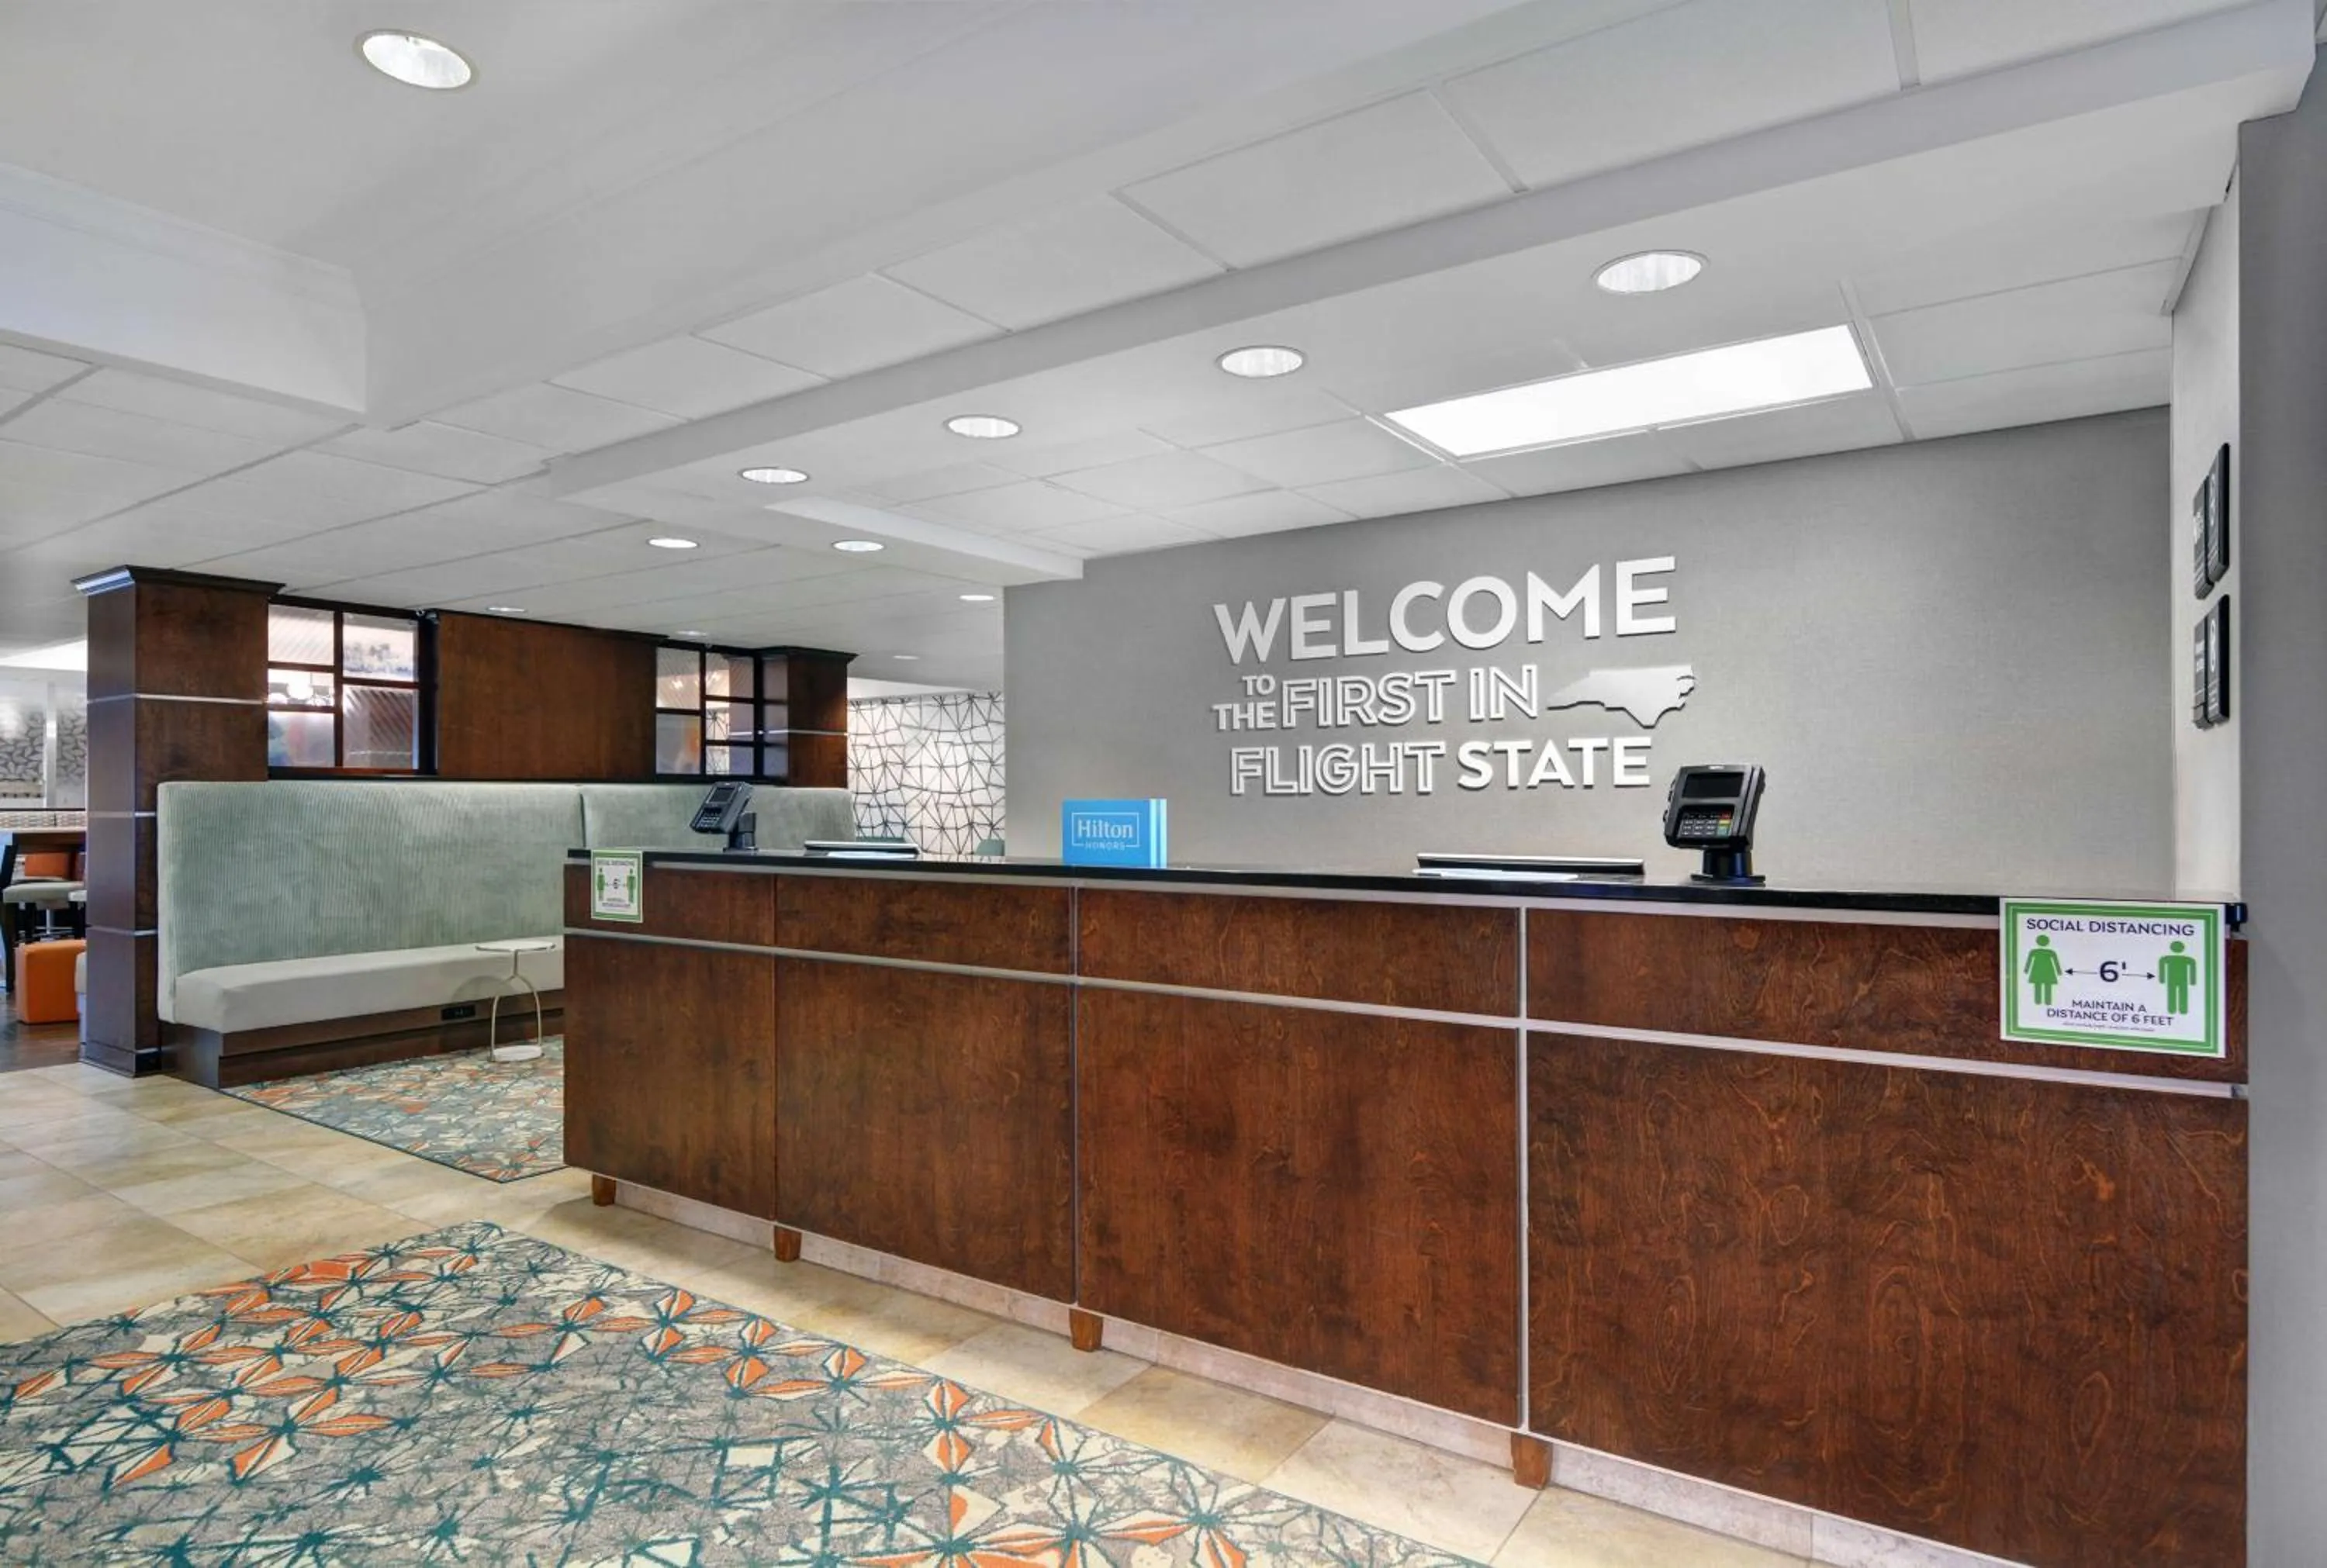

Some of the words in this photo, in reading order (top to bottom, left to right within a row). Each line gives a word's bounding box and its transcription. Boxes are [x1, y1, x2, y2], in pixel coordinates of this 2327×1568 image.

[1213, 556, 1676, 665] WELCOME
[1243, 675, 1275, 696] TO
[1282, 670, 1456, 728] FIRST
[1470, 665, 1537, 721] IN
[1213, 701, 1276, 730] THE
[1231, 742, 1446, 795] FLIGHT
[1457, 737, 1652, 789] STATE
[1077, 819, 1133, 838] Hilton
[2027, 918, 2083, 932] SOCIAL
[2089, 920, 2194, 936] DISTANCING
[2099, 961, 2126, 983] 6'
[2072, 1000, 2134, 1011] MAINTAIN
[2138, 1004, 2147, 1013] A
[2047, 1010, 2107, 1021] DISTANCE
[2111, 1014, 2128, 1023] OF
[2132, 1014, 2140, 1024] 6
[2143, 1016, 2174, 1026] FEET
